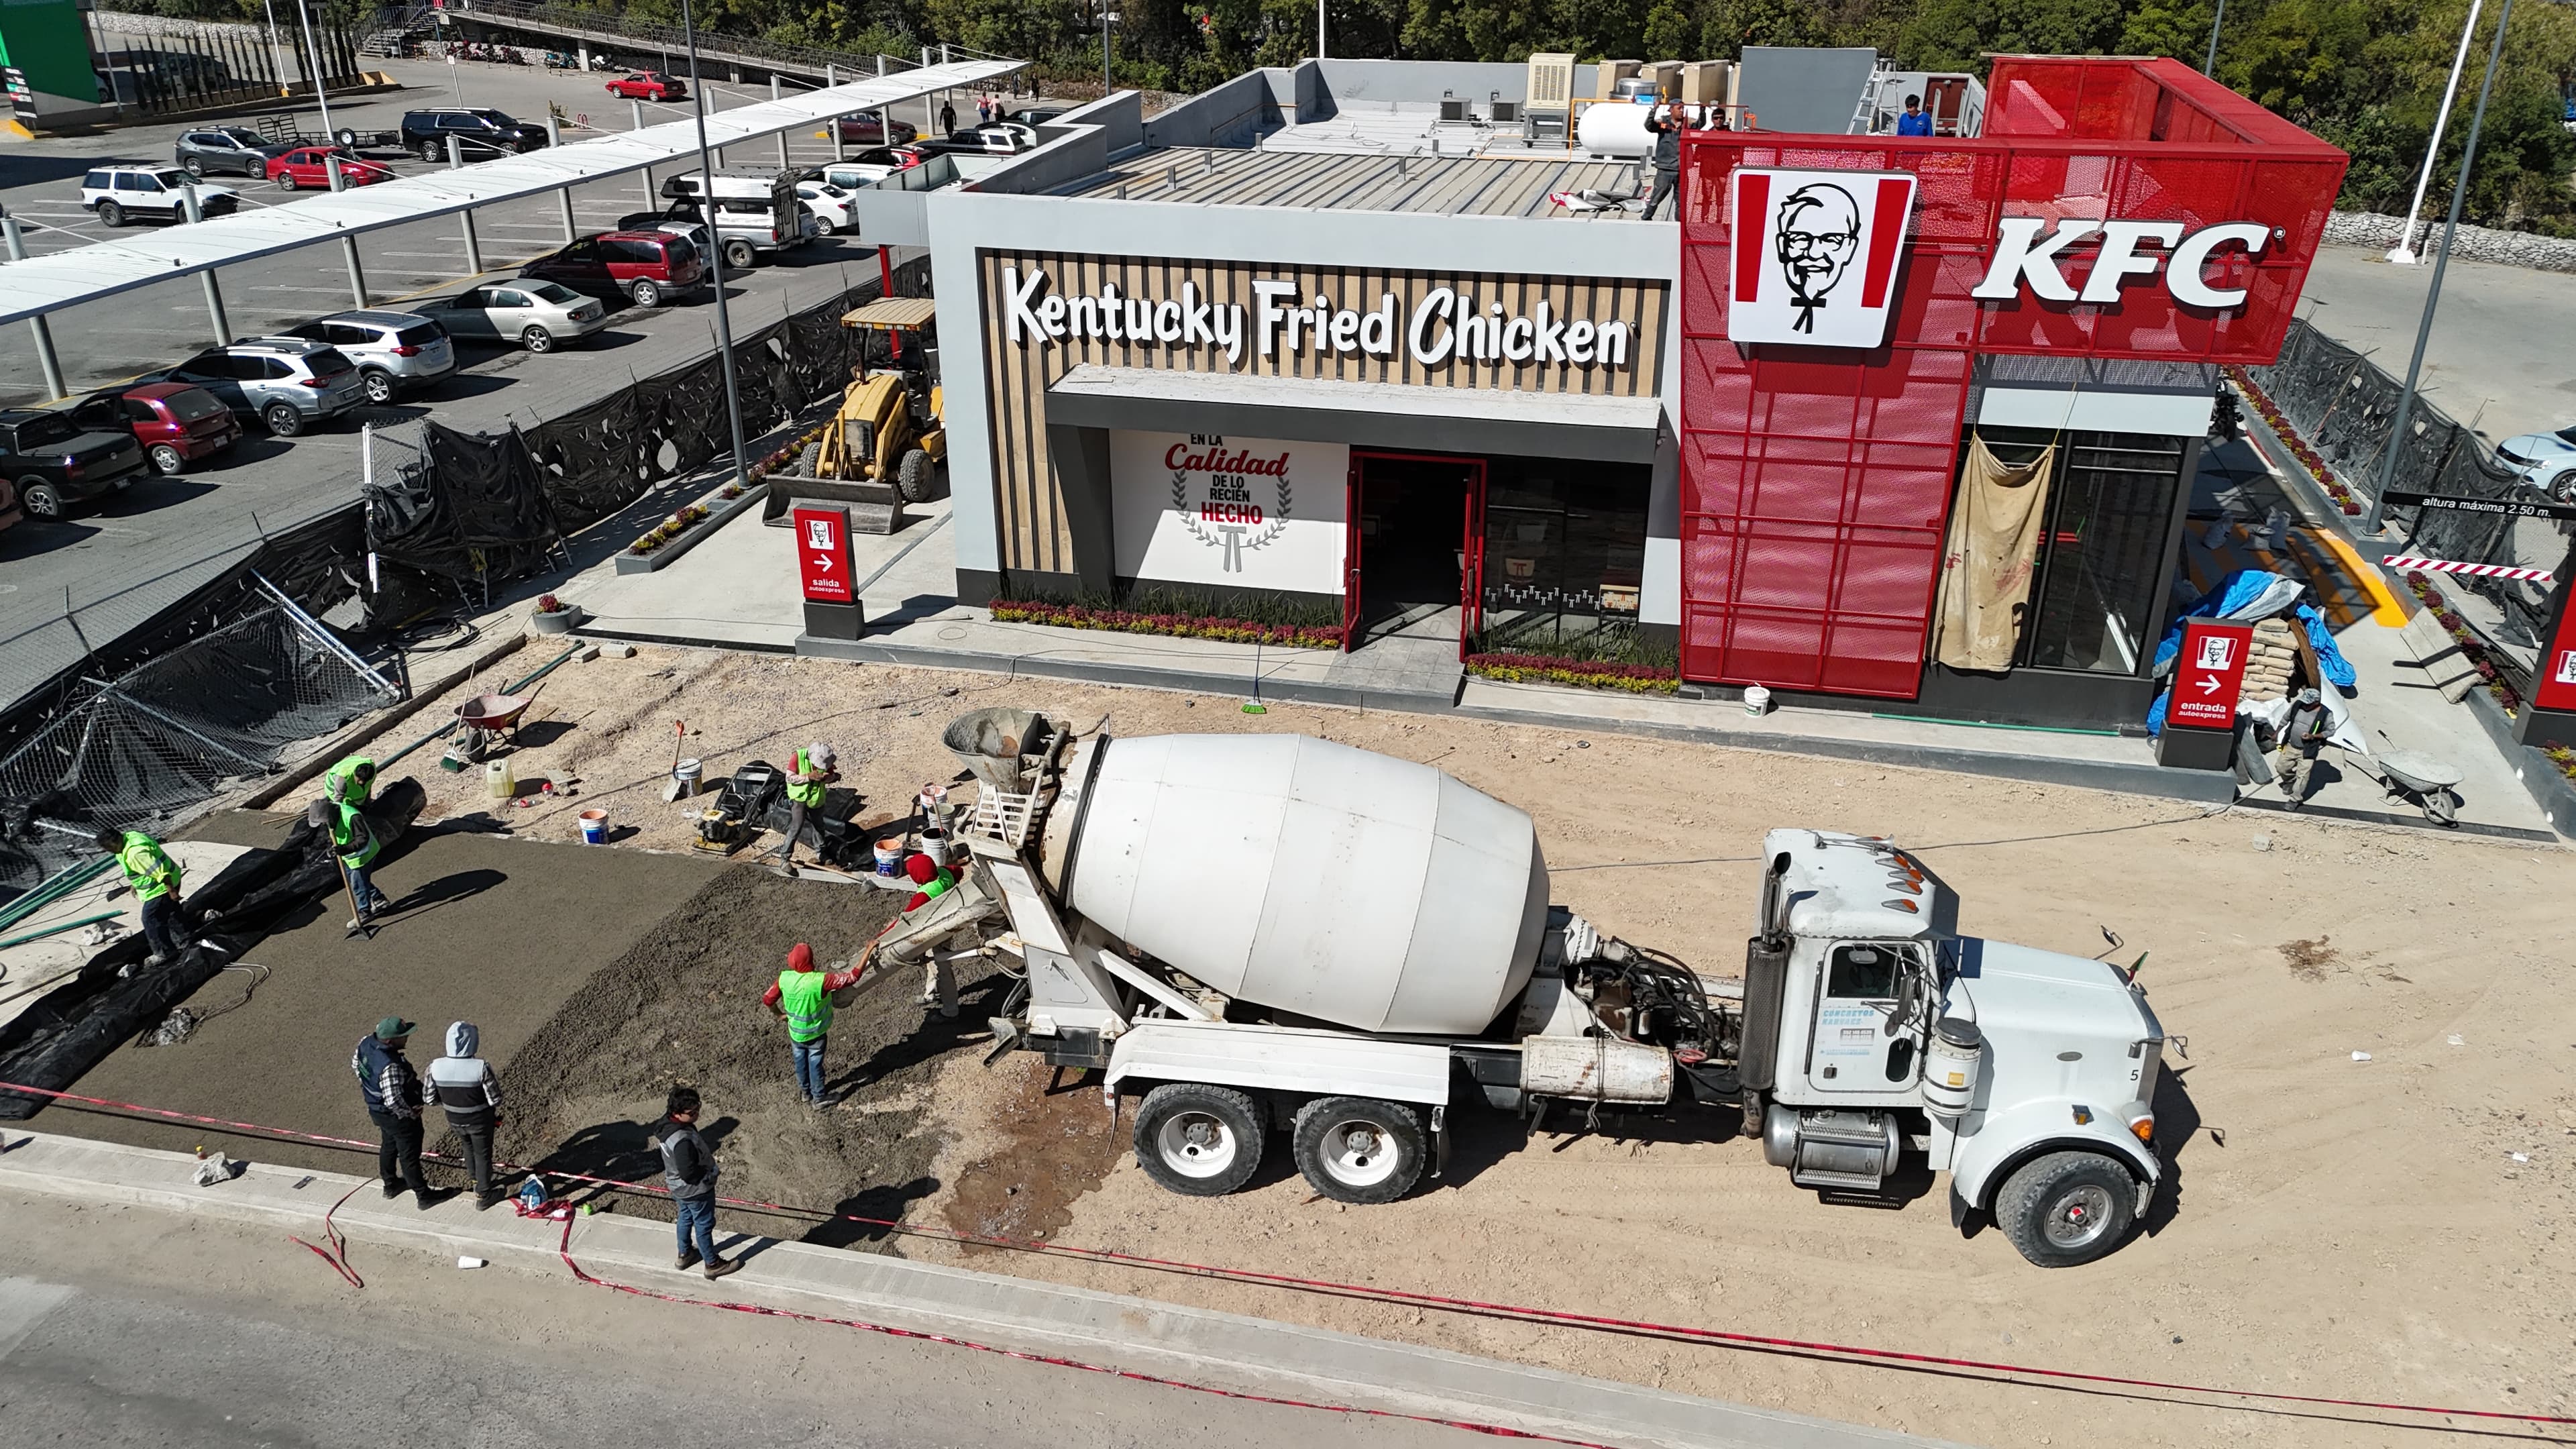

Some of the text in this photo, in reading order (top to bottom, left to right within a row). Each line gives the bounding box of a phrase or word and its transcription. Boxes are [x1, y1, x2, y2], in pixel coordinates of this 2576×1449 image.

[1971, 218, 2270, 307] KFC
[1004, 266, 1628, 365] Kentucky Fried Chicken
[1191, 433, 1223, 446] EN LA
[1165, 443, 1289, 476] Calidad
[1212, 475, 1244, 488] DE LO
[1201, 502, 1263, 525] HECHO
[2422, 497, 2552, 517] altura máxima 2.50 m.
[812, 578, 840, 588] salida
[808, 586, 845, 594] autoexpress
[2181, 702, 2226, 712] entrada
[2178, 710, 2226, 719] autoexpress
[2130, 1069, 2139, 1081] 5
